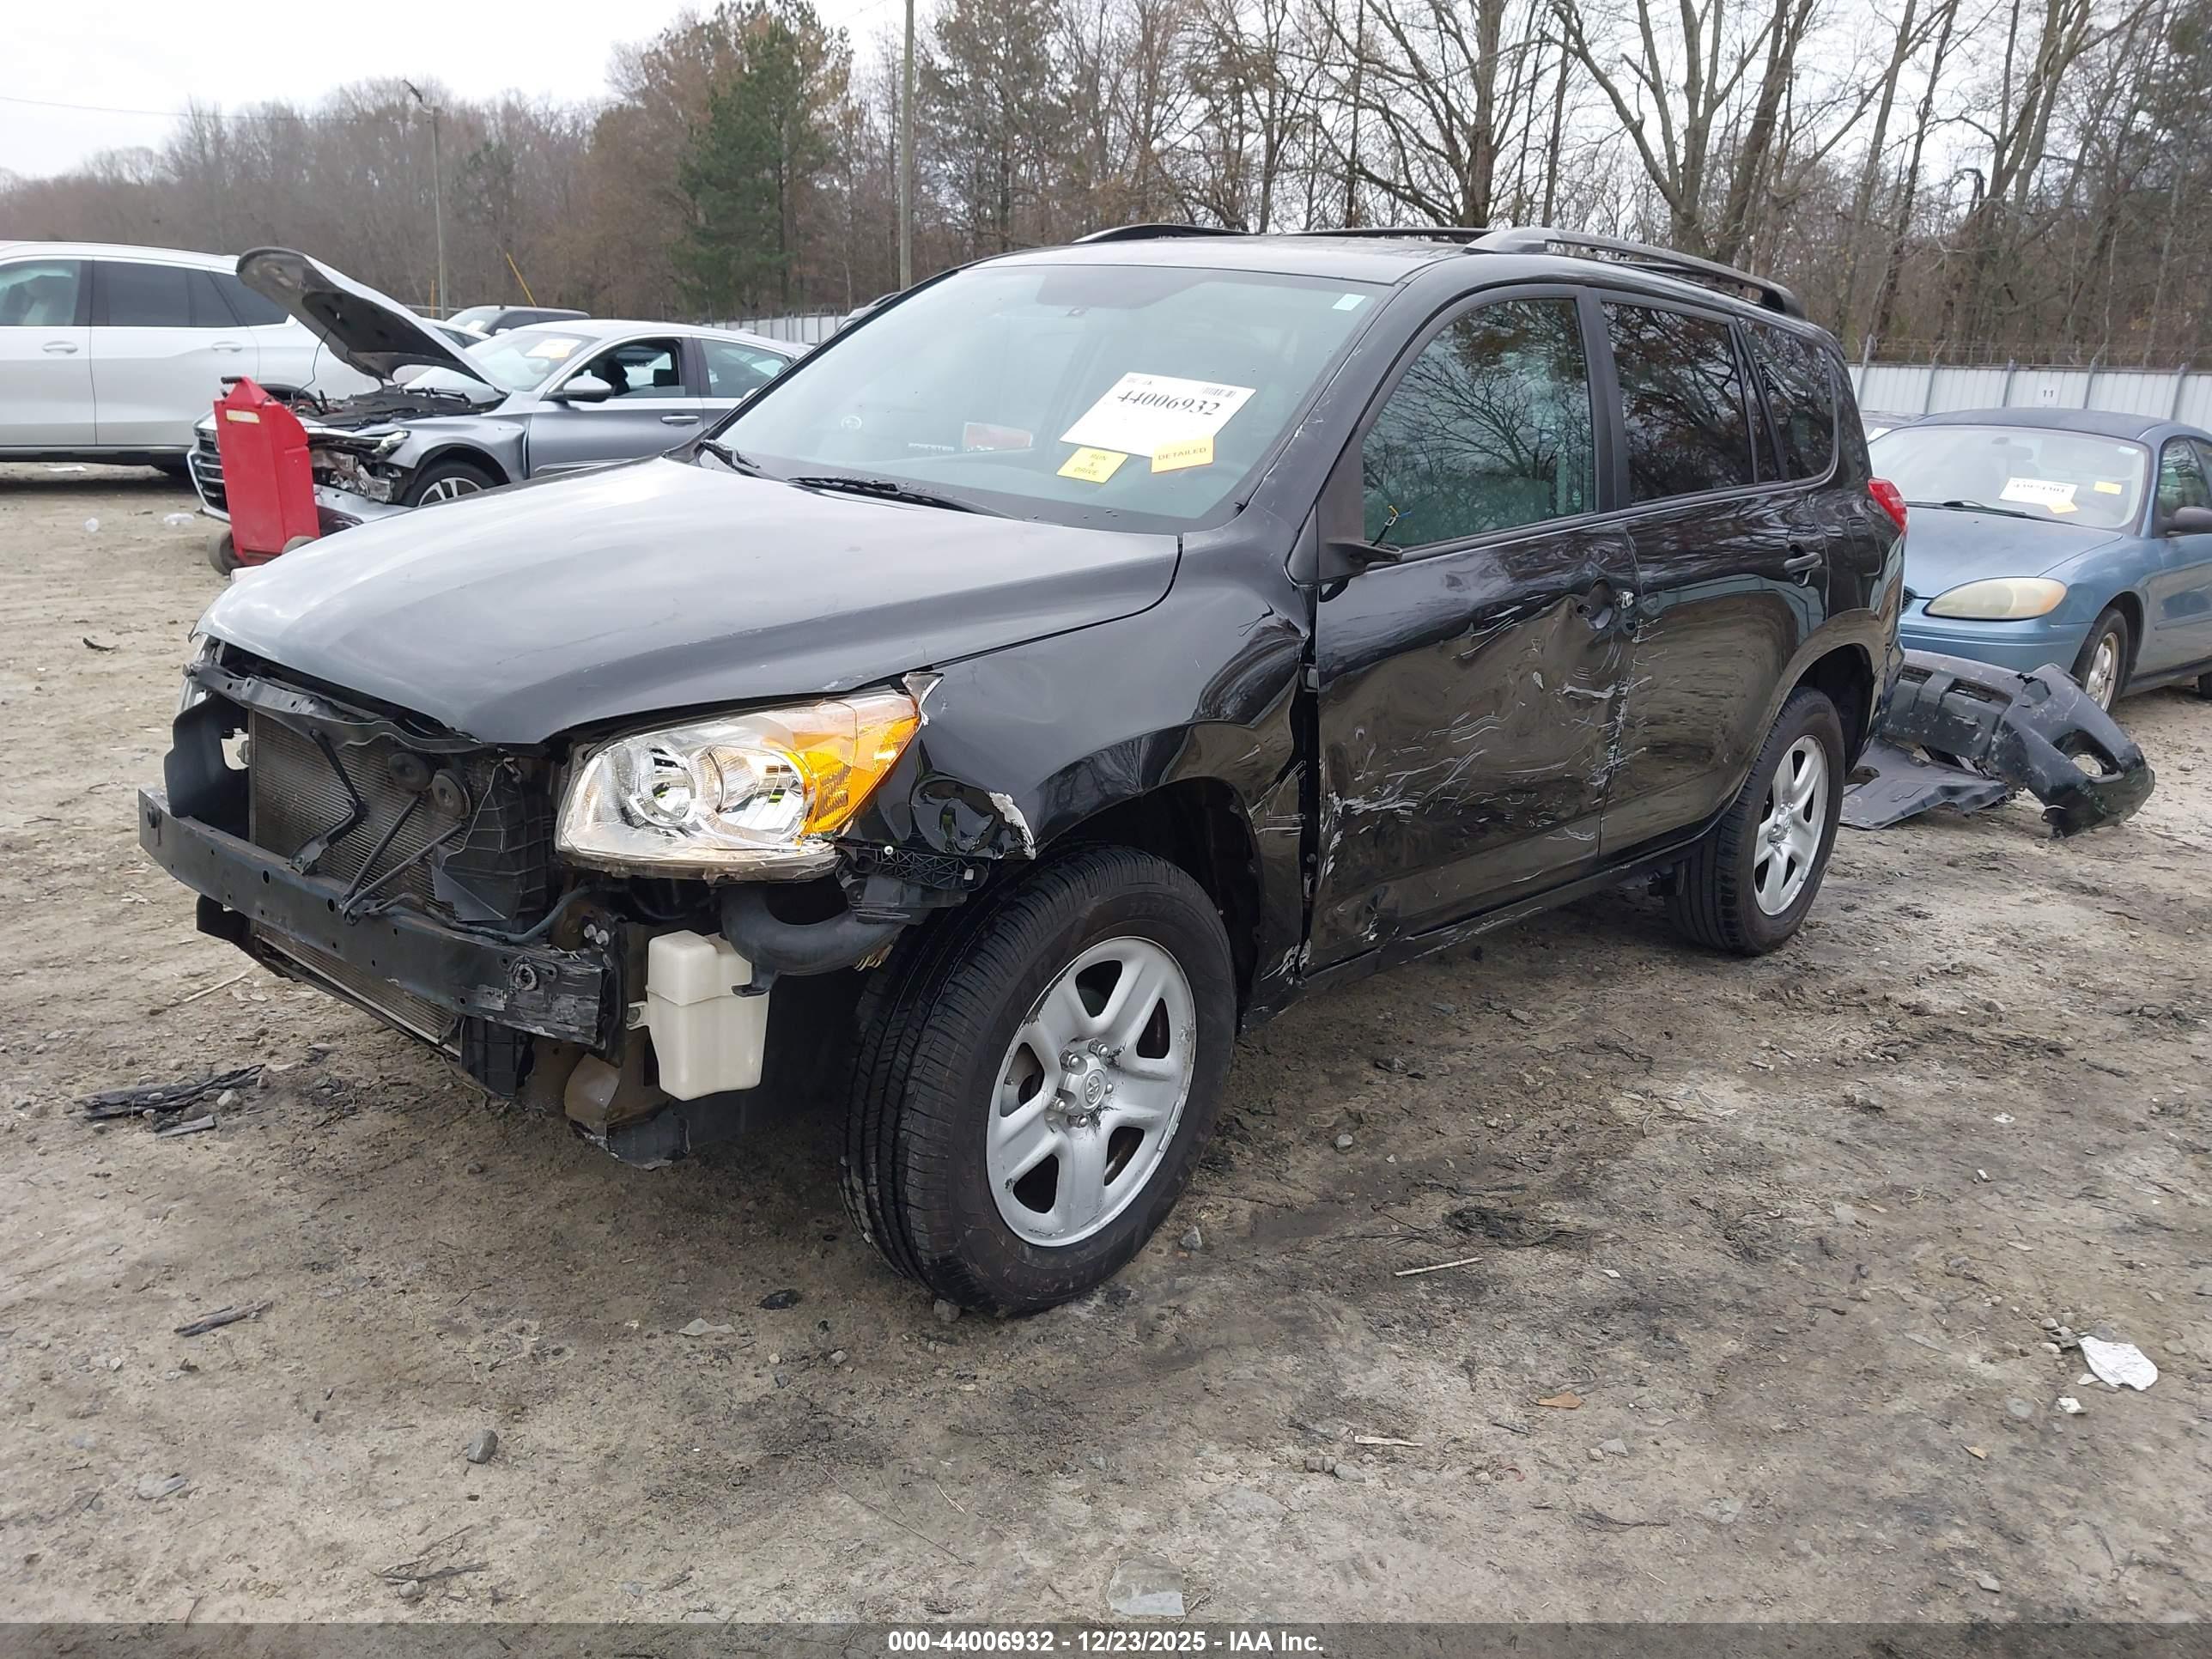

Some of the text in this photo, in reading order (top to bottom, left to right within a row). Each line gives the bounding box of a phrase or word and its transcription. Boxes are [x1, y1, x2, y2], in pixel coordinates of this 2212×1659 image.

[2041, 389, 2055, 398] 11
[1117, 390, 1220, 416] 44006932
[1158, 447, 1207, 461] DETAILED
[1073, 466, 1099, 476] DRIVE
